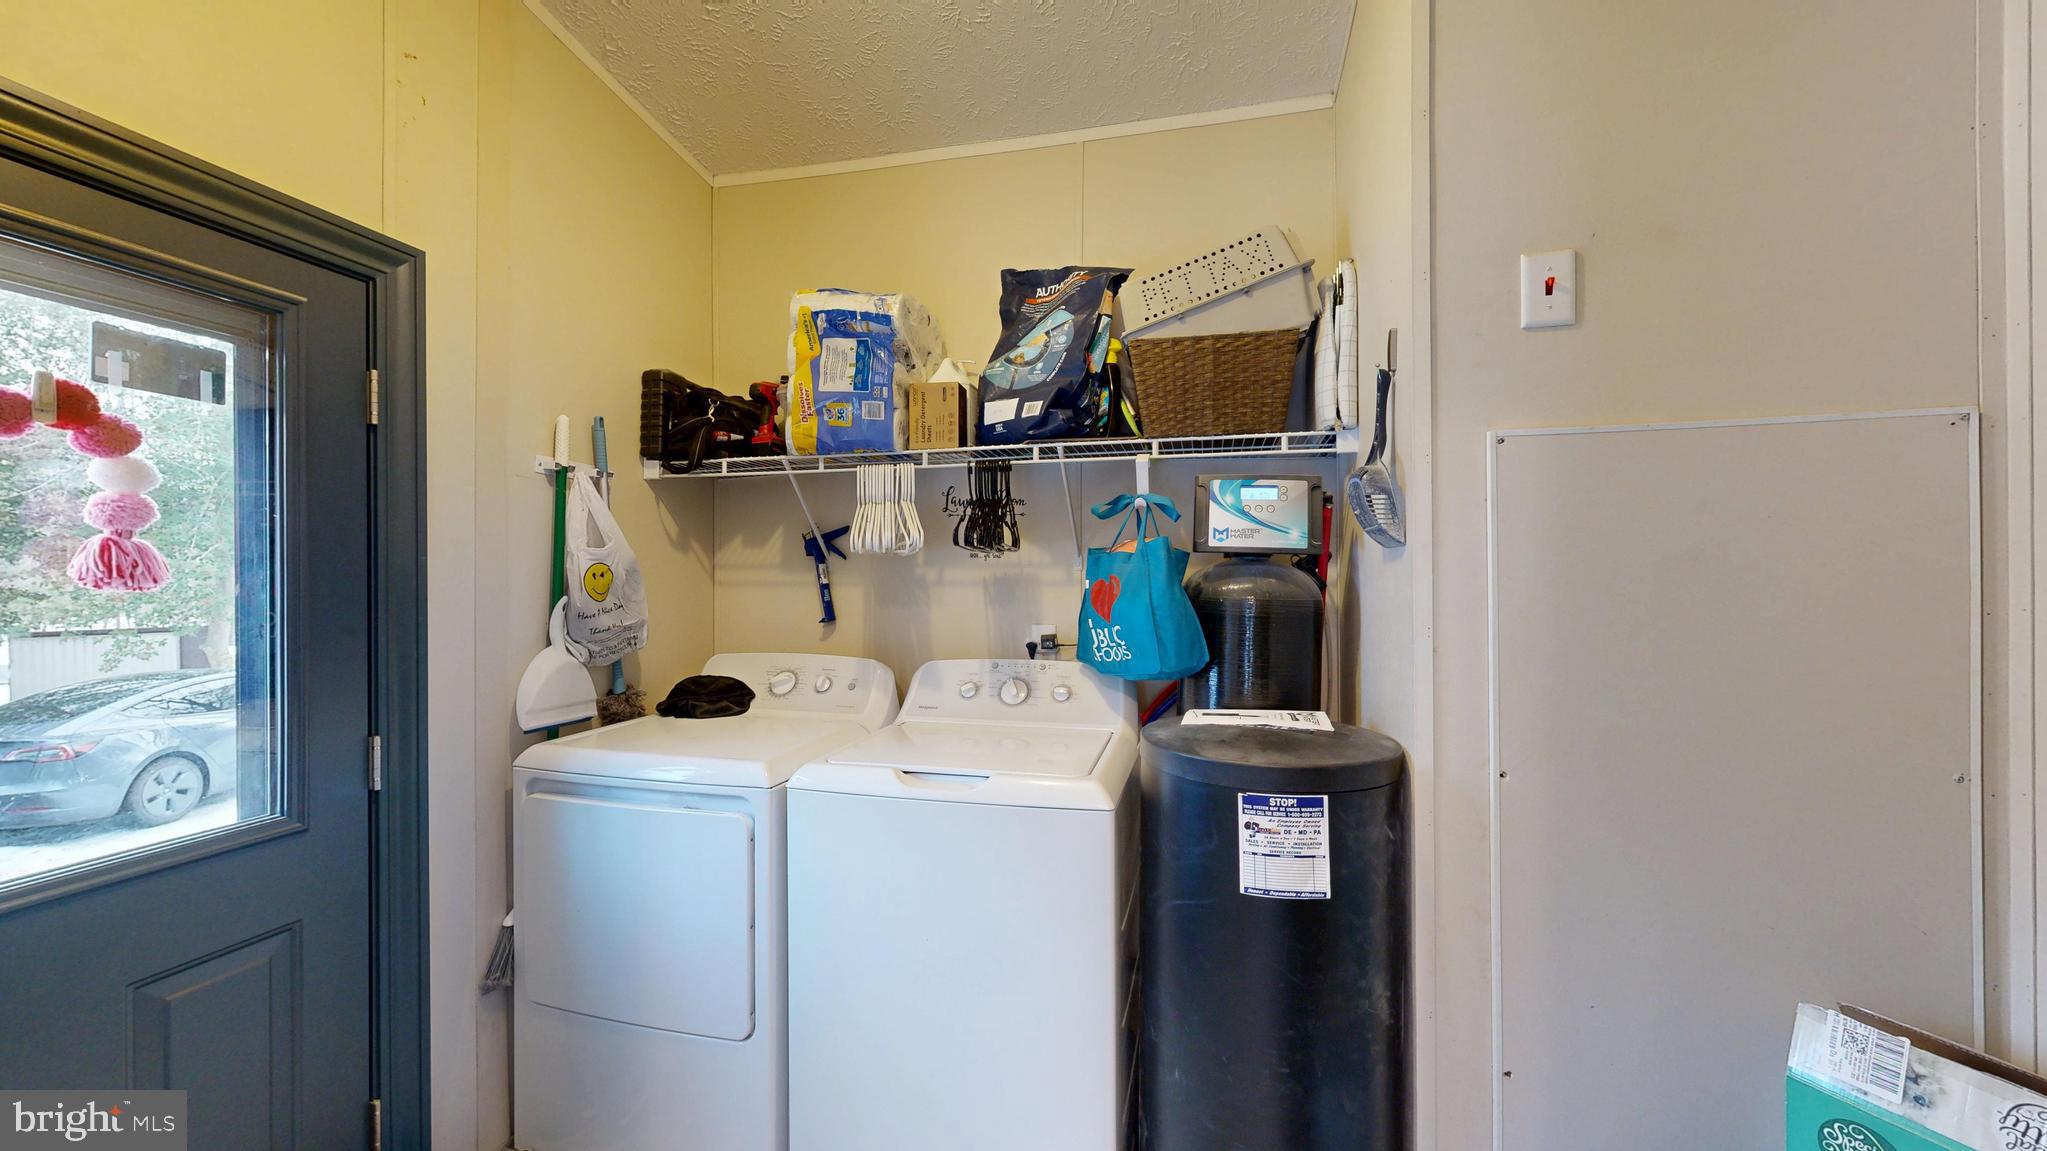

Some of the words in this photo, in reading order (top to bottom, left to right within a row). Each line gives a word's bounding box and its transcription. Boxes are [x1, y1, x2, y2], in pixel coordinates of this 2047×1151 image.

[798, 382, 808, 422] Dissolves
[804, 388, 814, 417] Faster
[837, 408, 845, 421] 36
[613, 602, 624, 610] Day
[1269, 798, 1297, 806] STOP!
